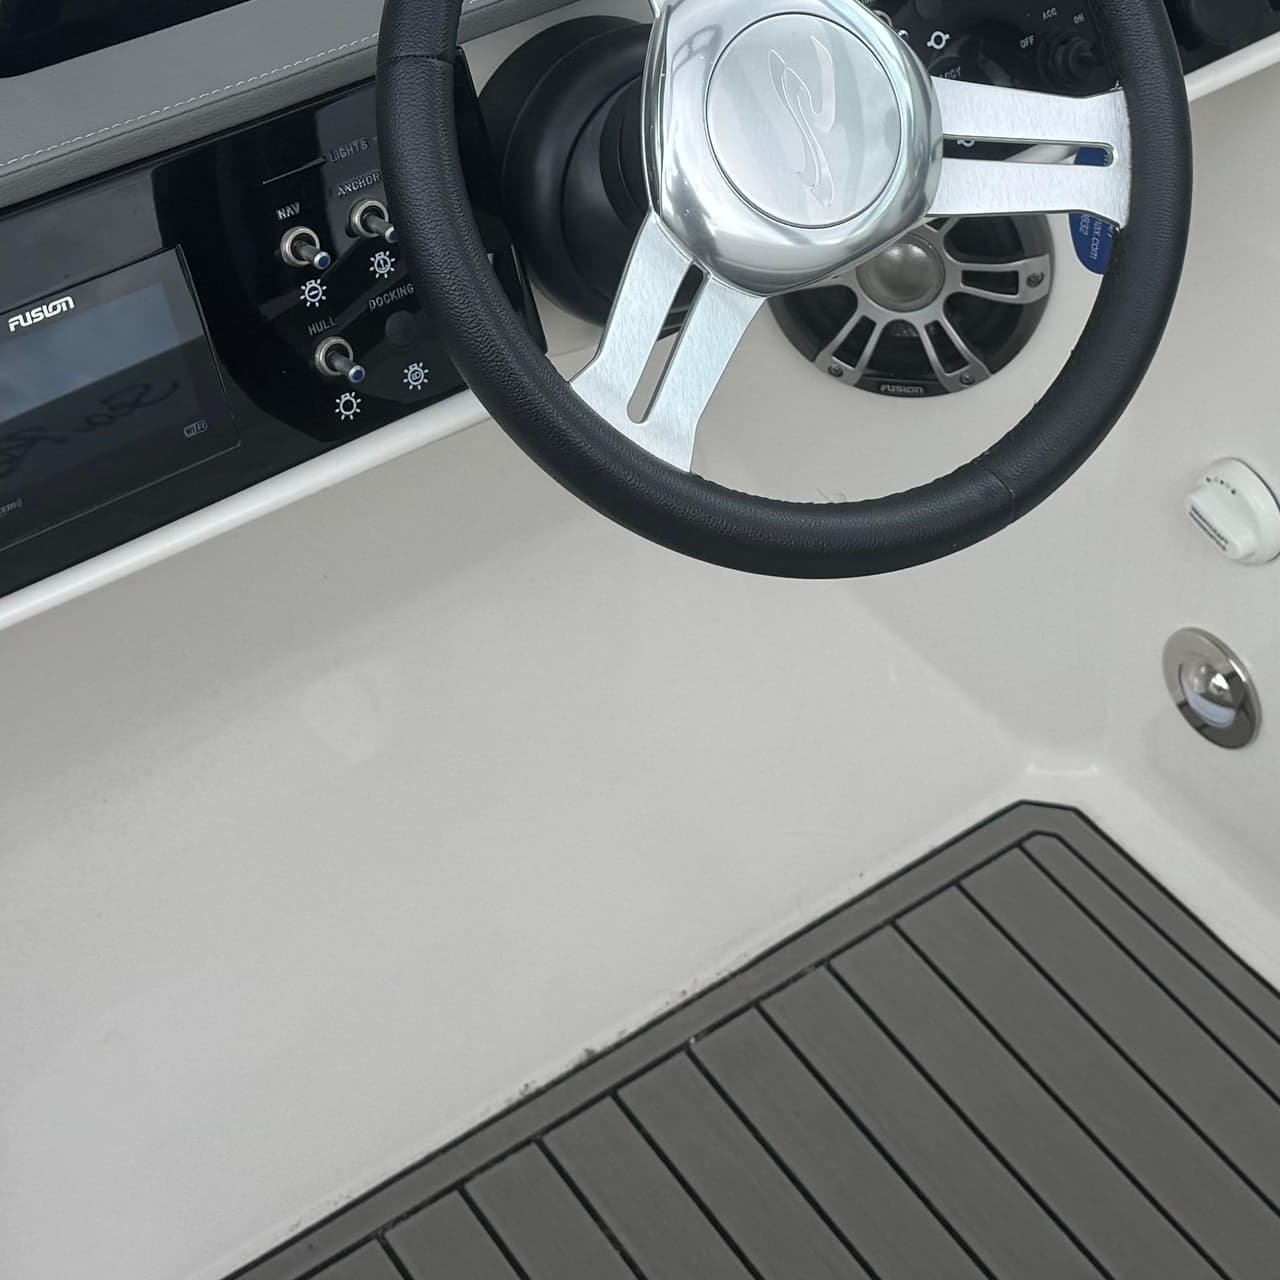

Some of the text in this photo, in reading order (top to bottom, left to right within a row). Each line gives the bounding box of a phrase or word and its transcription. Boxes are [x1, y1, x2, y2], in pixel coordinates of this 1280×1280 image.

[1019, 34, 1034, 49] OFF
[328, 138, 369, 163] LIGHTS
[337, 169, 381, 197] ANCHOR
[276, 201, 301, 221] NAV
[367, 283, 415, 312] DOCKING
[307, 316, 337, 337] HULL
